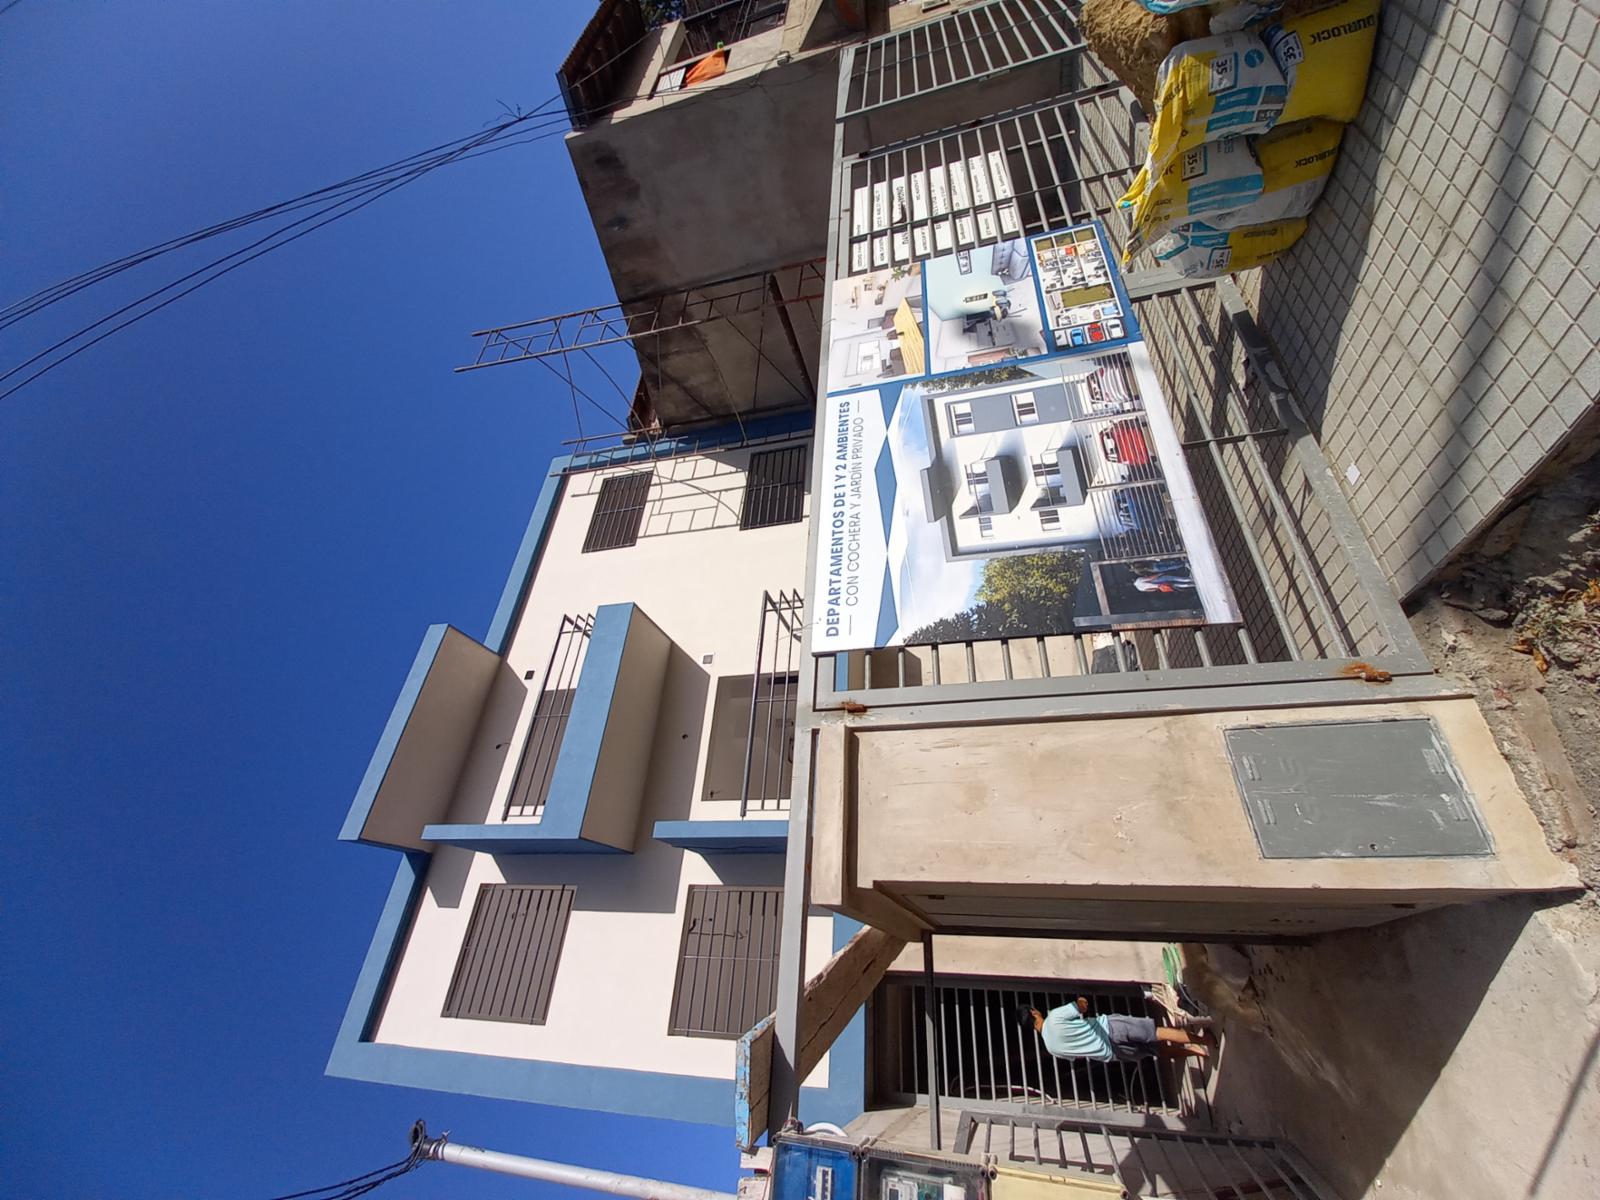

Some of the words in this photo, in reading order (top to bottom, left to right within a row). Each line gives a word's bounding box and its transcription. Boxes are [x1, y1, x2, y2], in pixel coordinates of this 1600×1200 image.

[1309, 14, 1375, 45] DURLOCK
[1282, 46, 1297, 61] 35
[1215, 59, 1228, 75] 35
[1187, 152, 1198, 166] 35
[1215, 257, 1224, 269] 35
[836, 401, 850, 460] AMBIENTES
[851, 416, 864, 460] PRIVADO
[835, 463, 847, 471] 2
[834, 474, 847, 482] Y
[849, 462, 863, 499] JARDÍN
[833, 491, 846, 507] DE
[849, 502, 861, 510] Y
[847, 511, 861, 572] COCHERA
[826, 511, 845, 637] DEPARTAMENTOS
[845, 575, 859, 606] CON
